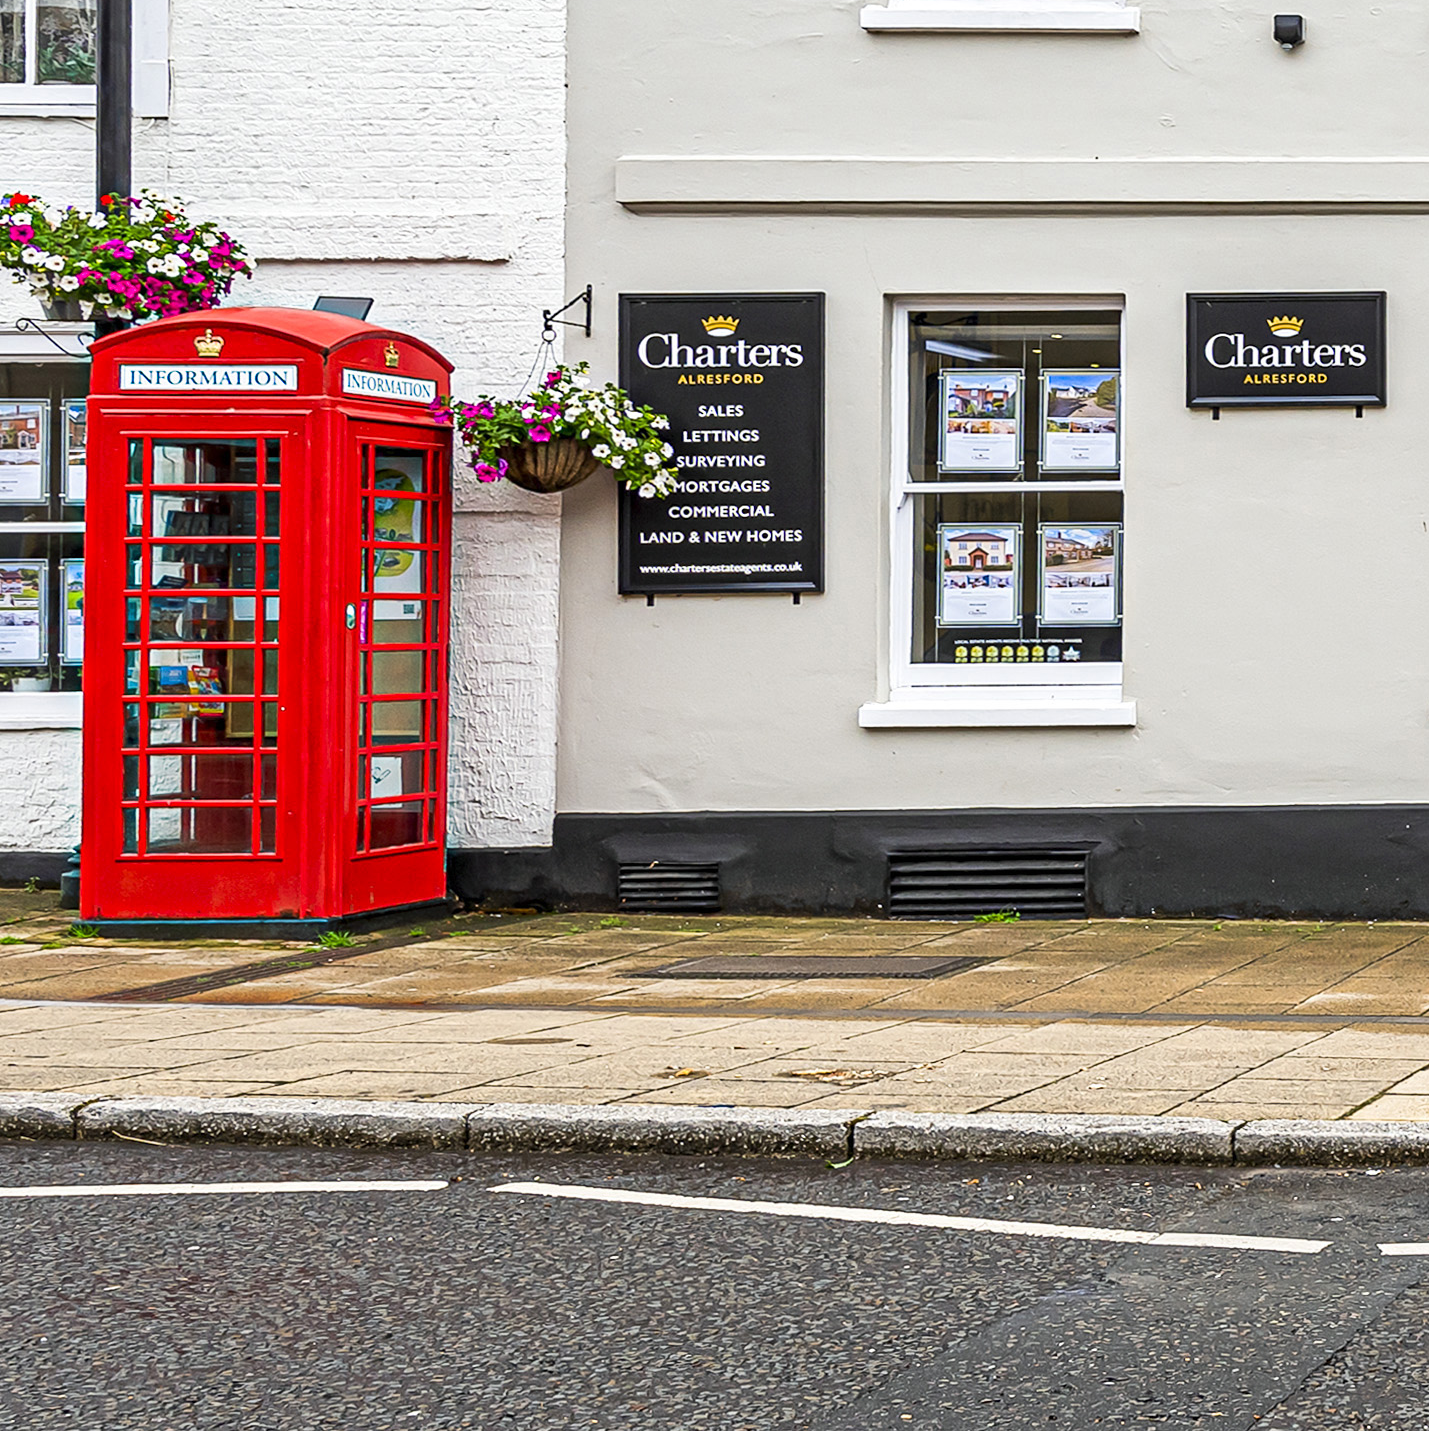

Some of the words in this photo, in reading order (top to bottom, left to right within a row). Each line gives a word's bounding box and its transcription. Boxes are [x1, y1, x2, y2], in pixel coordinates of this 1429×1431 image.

[637, 332, 804, 369] Charters
[1204, 333, 1367, 369] Charters
[129, 369, 288, 387] INFORMATION
[677, 373, 765, 385] ALRESFORD
[1243, 373, 1328, 384] ALRESFORD
[346, 373, 432, 398] INFORMATION
[697, 404, 745, 418] SALES
[682, 429, 760, 443] LETTINGS
[676, 454, 766, 468] SURVEYING
[673, 480, 771, 494] MORTGAGES
[668, 505, 775, 519] COMMERCIAL
[639, 531, 685, 545] LAND
[688, 531, 701, 545] &
[704, 530, 743, 543] NEW
[746, 529, 803, 543] HOMES
[639, 561, 803, 575] www.chartersestateagents.co.uk
